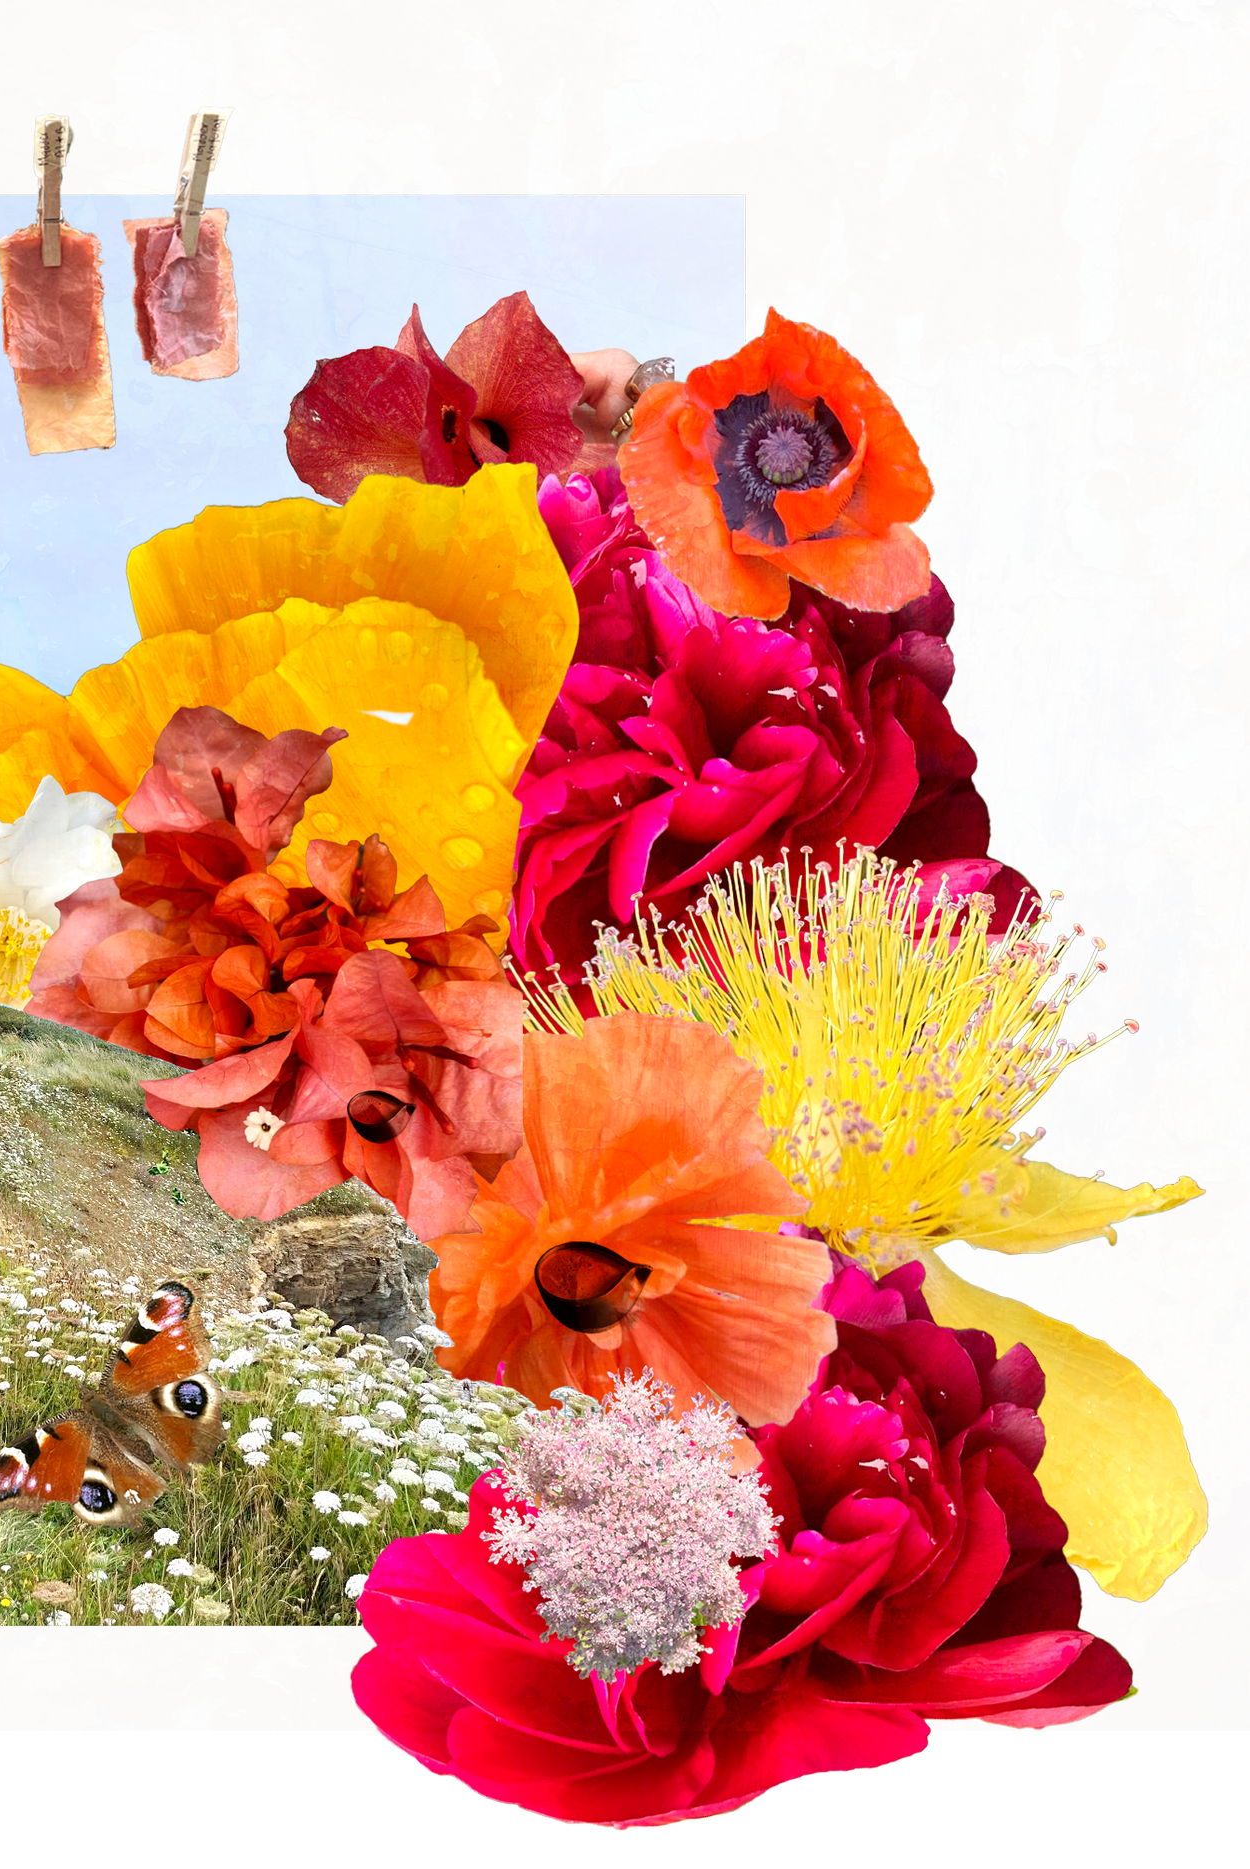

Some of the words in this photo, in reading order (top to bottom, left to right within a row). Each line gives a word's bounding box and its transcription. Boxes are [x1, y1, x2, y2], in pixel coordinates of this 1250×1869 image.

[37, 132, 51, 166] Madder
[192, 122, 209, 162] Madder
[206, 118, 225, 161] Natural
